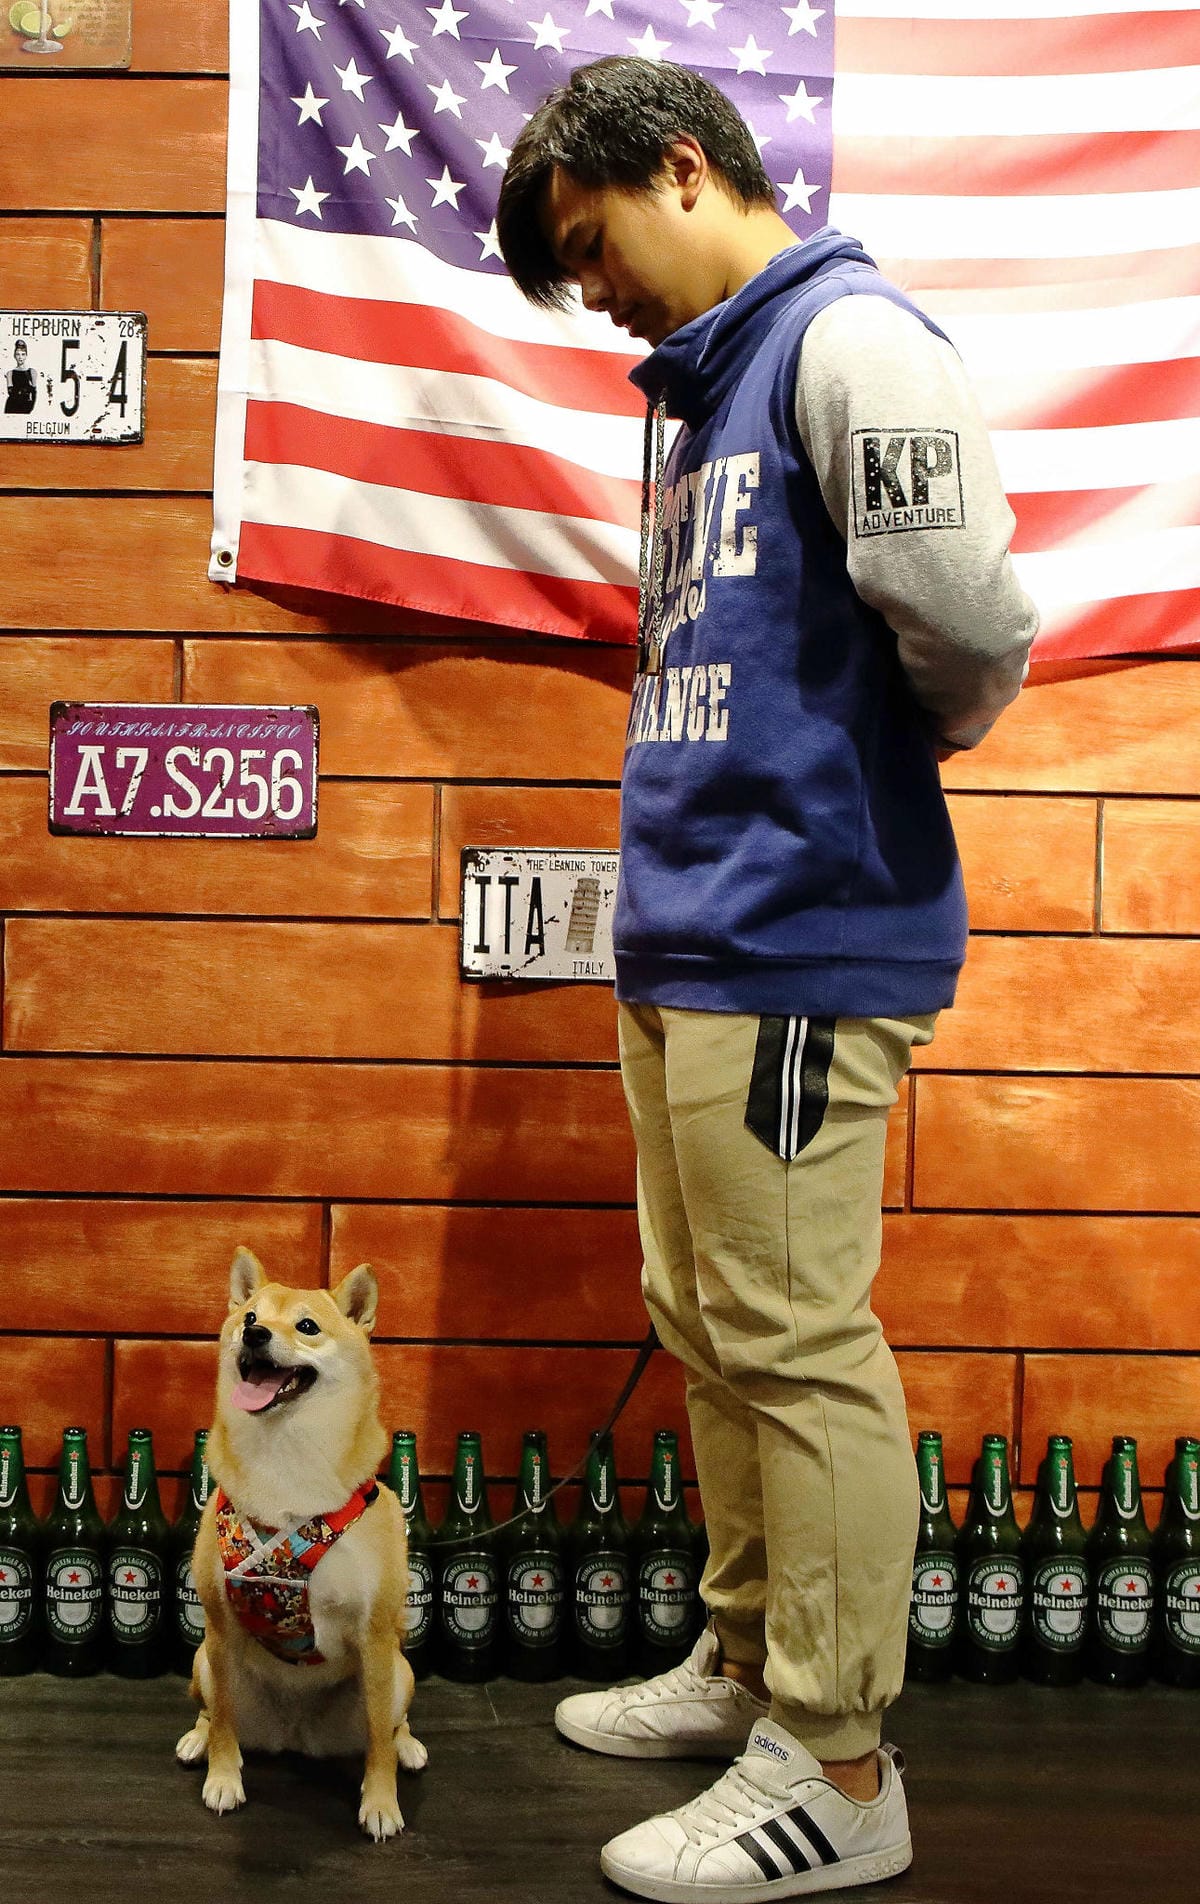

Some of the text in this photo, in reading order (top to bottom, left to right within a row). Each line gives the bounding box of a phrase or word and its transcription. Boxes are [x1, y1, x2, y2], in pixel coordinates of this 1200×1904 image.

[12, 318, 135, 338] HEPBURN 28
[26, 421, 71, 435] BELGIUM
[863, 436, 953, 511] KP
[862, 508, 956, 531] ADVENTURE
[63, 745, 304, 820] A7.S256
[528, 860, 617, 872] THE LEANING TOWER
[474, 876, 545, 955] ITA
[572, 961, 605, 975] ITALY
[47, 1584, 102, 1601] Heineken
[110, 1586, 161, 1601] eineken
[509, 1588, 561, 1604] Heineke
[754, 1734, 790, 1761] adidas
